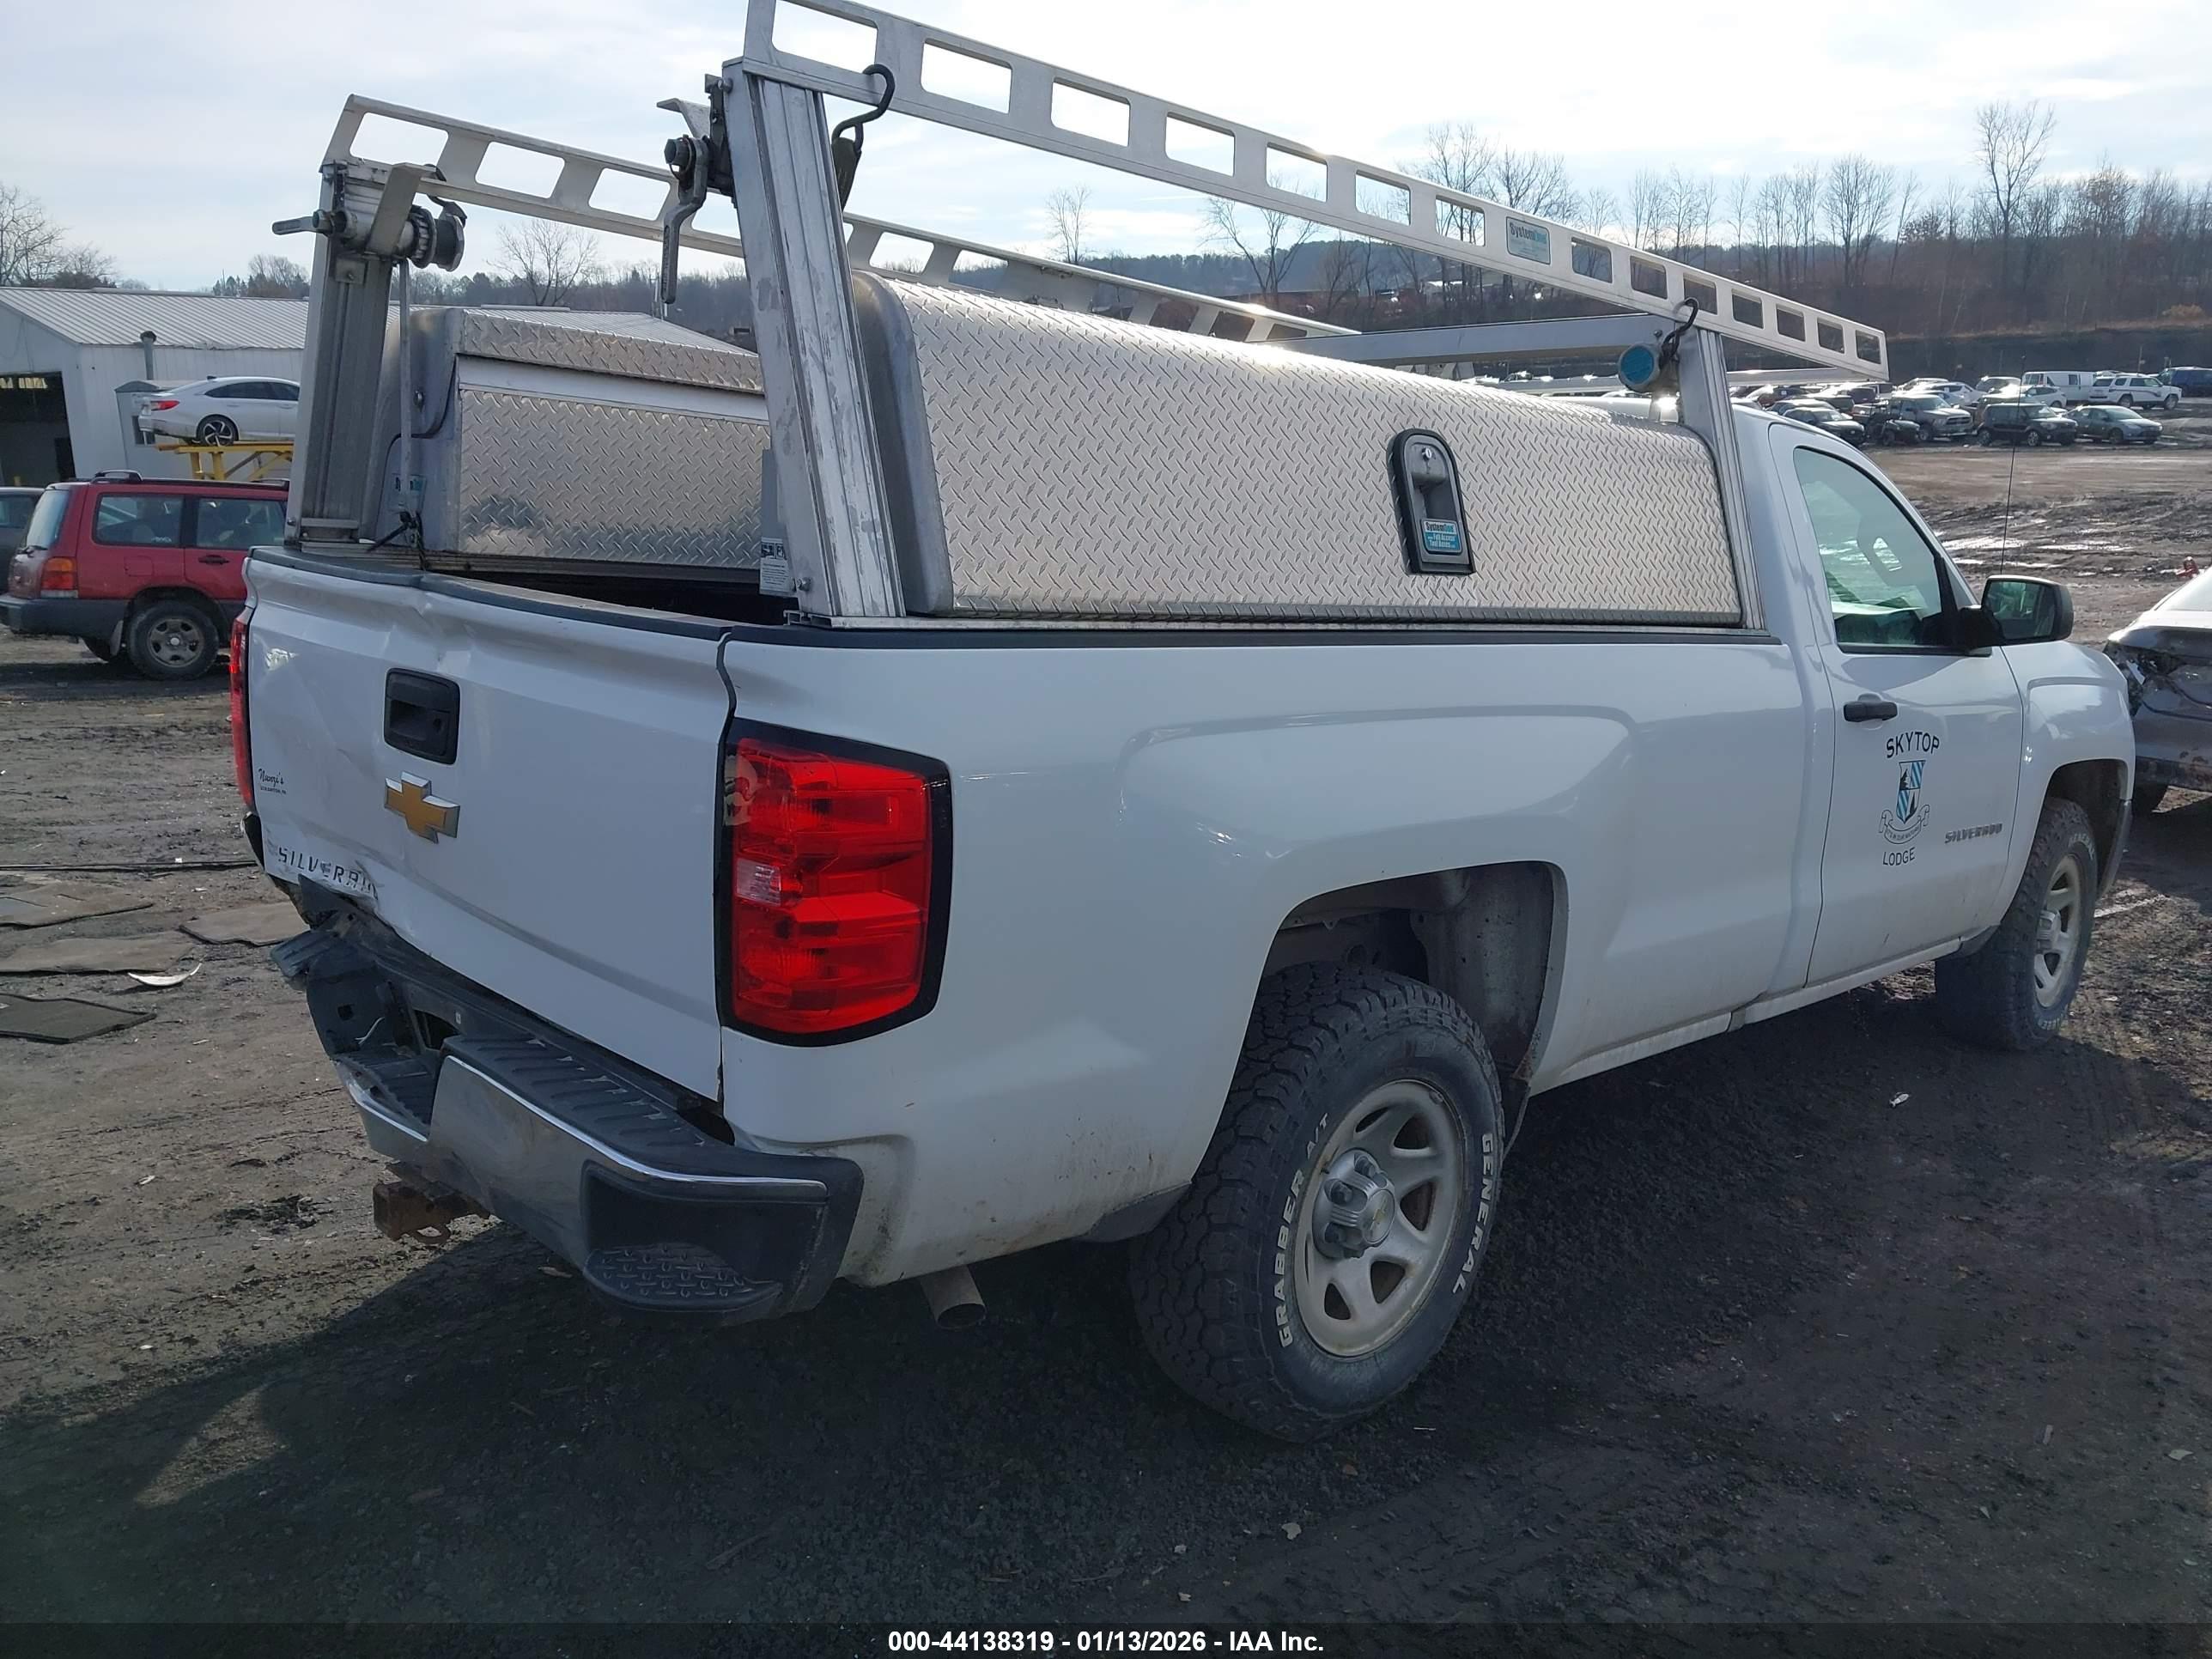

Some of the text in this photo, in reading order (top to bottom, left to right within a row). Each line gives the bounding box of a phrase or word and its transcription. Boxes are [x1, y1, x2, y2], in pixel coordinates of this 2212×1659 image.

[1509, 222, 1547, 245] System
[1887, 731, 1940, 759] SKYTOP
[1882, 847, 1915, 866] LODGE
[1452, 1133, 1496, 1294] GENERAL
[1274, 1112, 1328, 1347] GRABBER A/T
